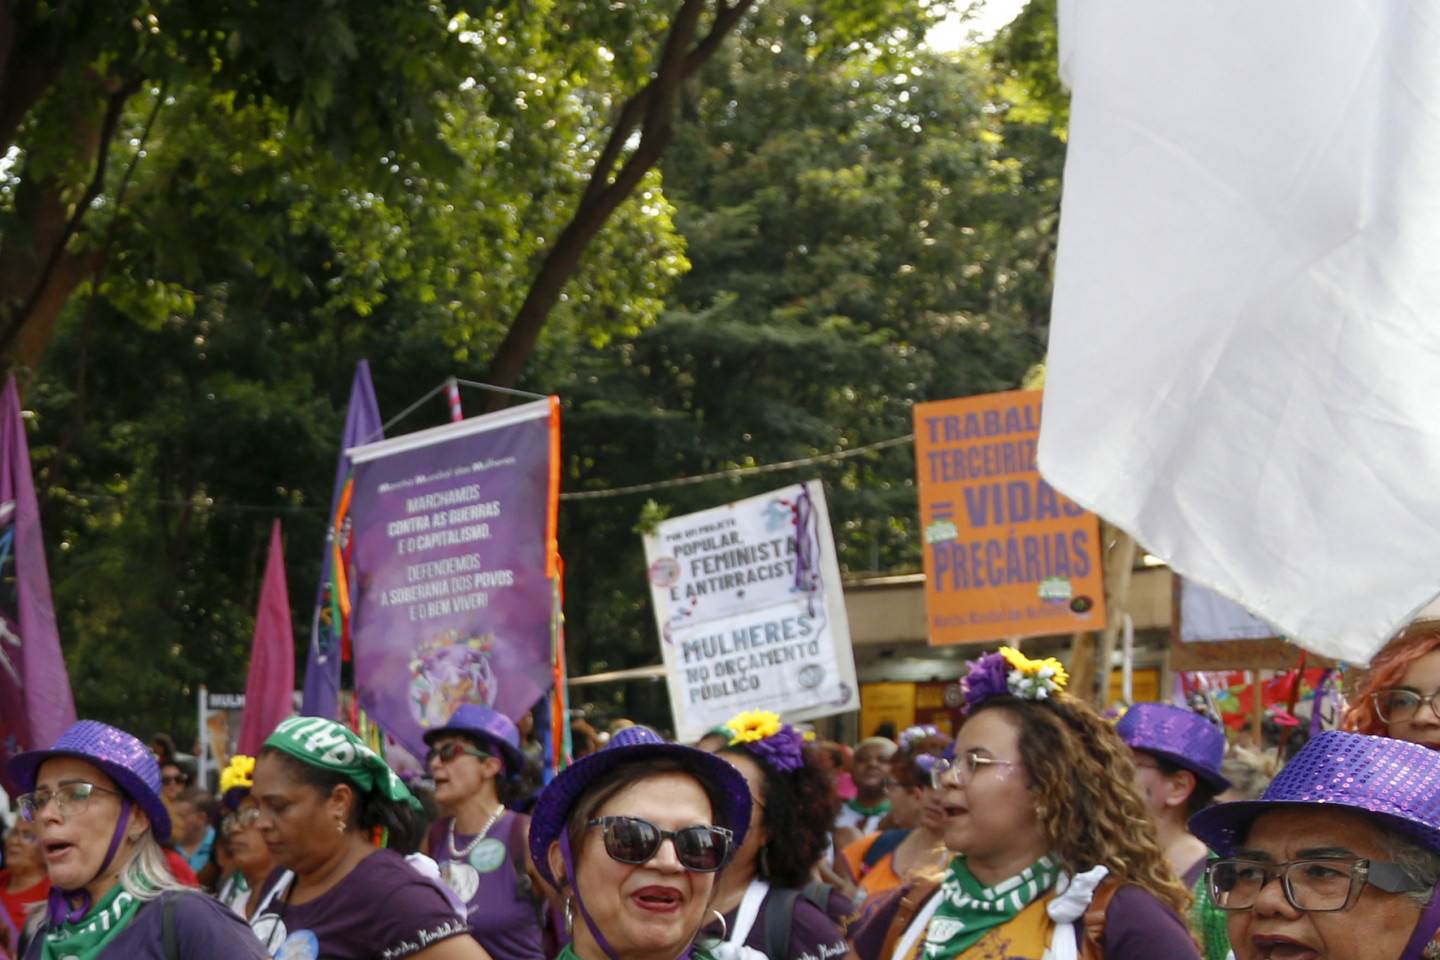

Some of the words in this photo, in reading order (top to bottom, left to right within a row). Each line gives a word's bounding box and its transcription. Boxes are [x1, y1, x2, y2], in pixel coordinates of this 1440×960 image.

[925, 403, 1042, 444] TRABAL
[406, 484, 480, 513] MARCHAMOS
[388, 515, 430, 537] CONTRA
[432, 511, 448, 528] AS
[449, 500, 501, 524] GUERRAS
[398, 538, 405, 555] E
[690, 536, 799, 577] FEMINISTA
[933, 529, 1092, 592] PRECÁRIAS
[408, 553, 480, 581] DEFENDEMOS
[670, 586, 679, 602] E
[686, 560, 796, 599] ANTIRRACIST
[381, 591, 389, 607] A
[389, 579, 449, 606] SOBERANIA
[451, 576, 472, 591] DOS
[474, 570, 513, 589] POVOS
[428, 597, 451, 618] BEM
[682, 613, 812, 663] MULHERES
[686, 666, 709, 684] NO
[714, 640, 820, 678] ORÇAMENTO
